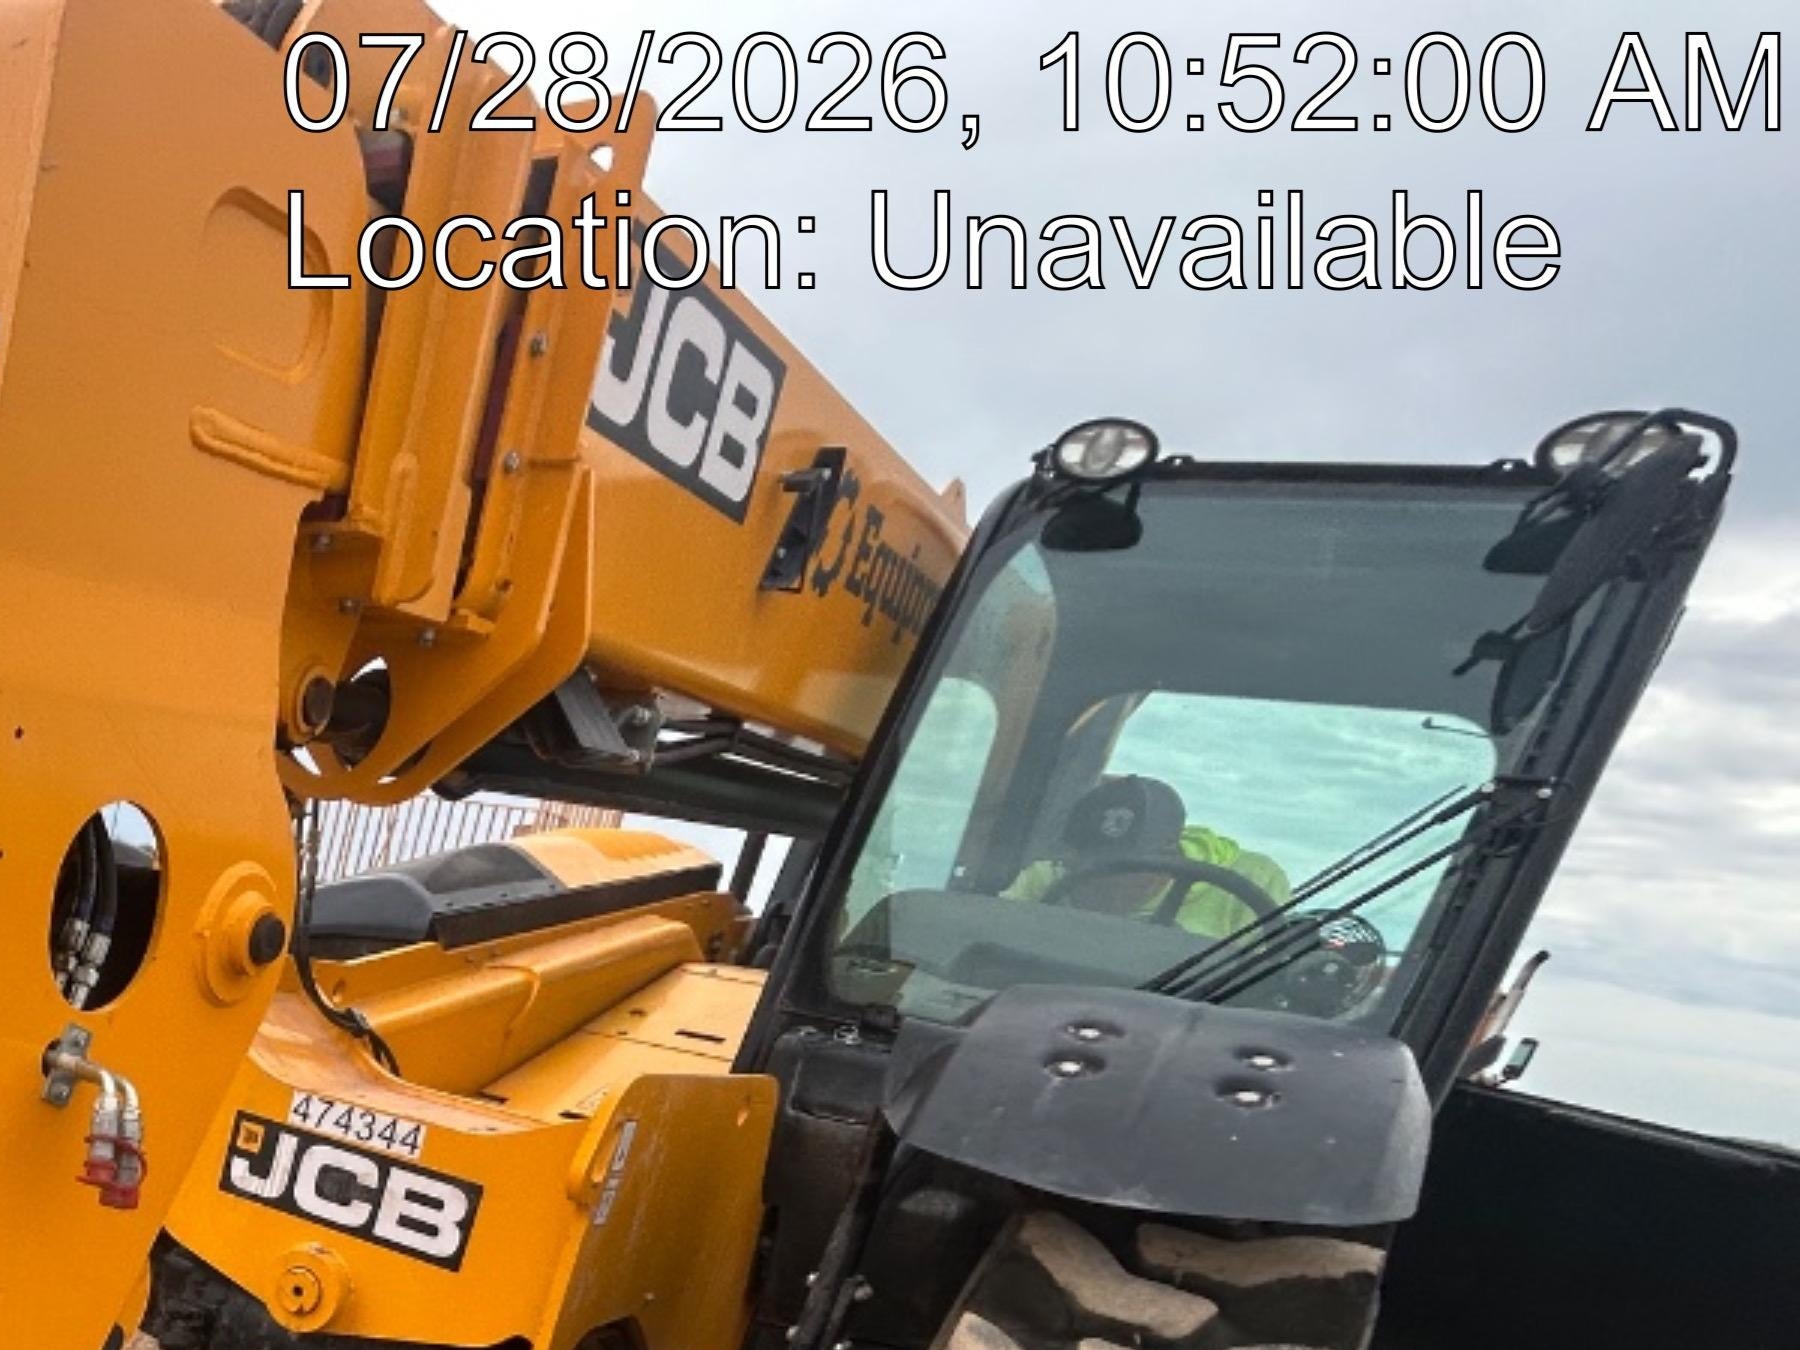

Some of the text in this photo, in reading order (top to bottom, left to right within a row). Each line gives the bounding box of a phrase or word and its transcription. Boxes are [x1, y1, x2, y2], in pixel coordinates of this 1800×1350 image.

[591, 280, 775, 502] JCB
[292, 1094, 422, 1155] 474344
[229, 1132, 470, 1258] JCB
